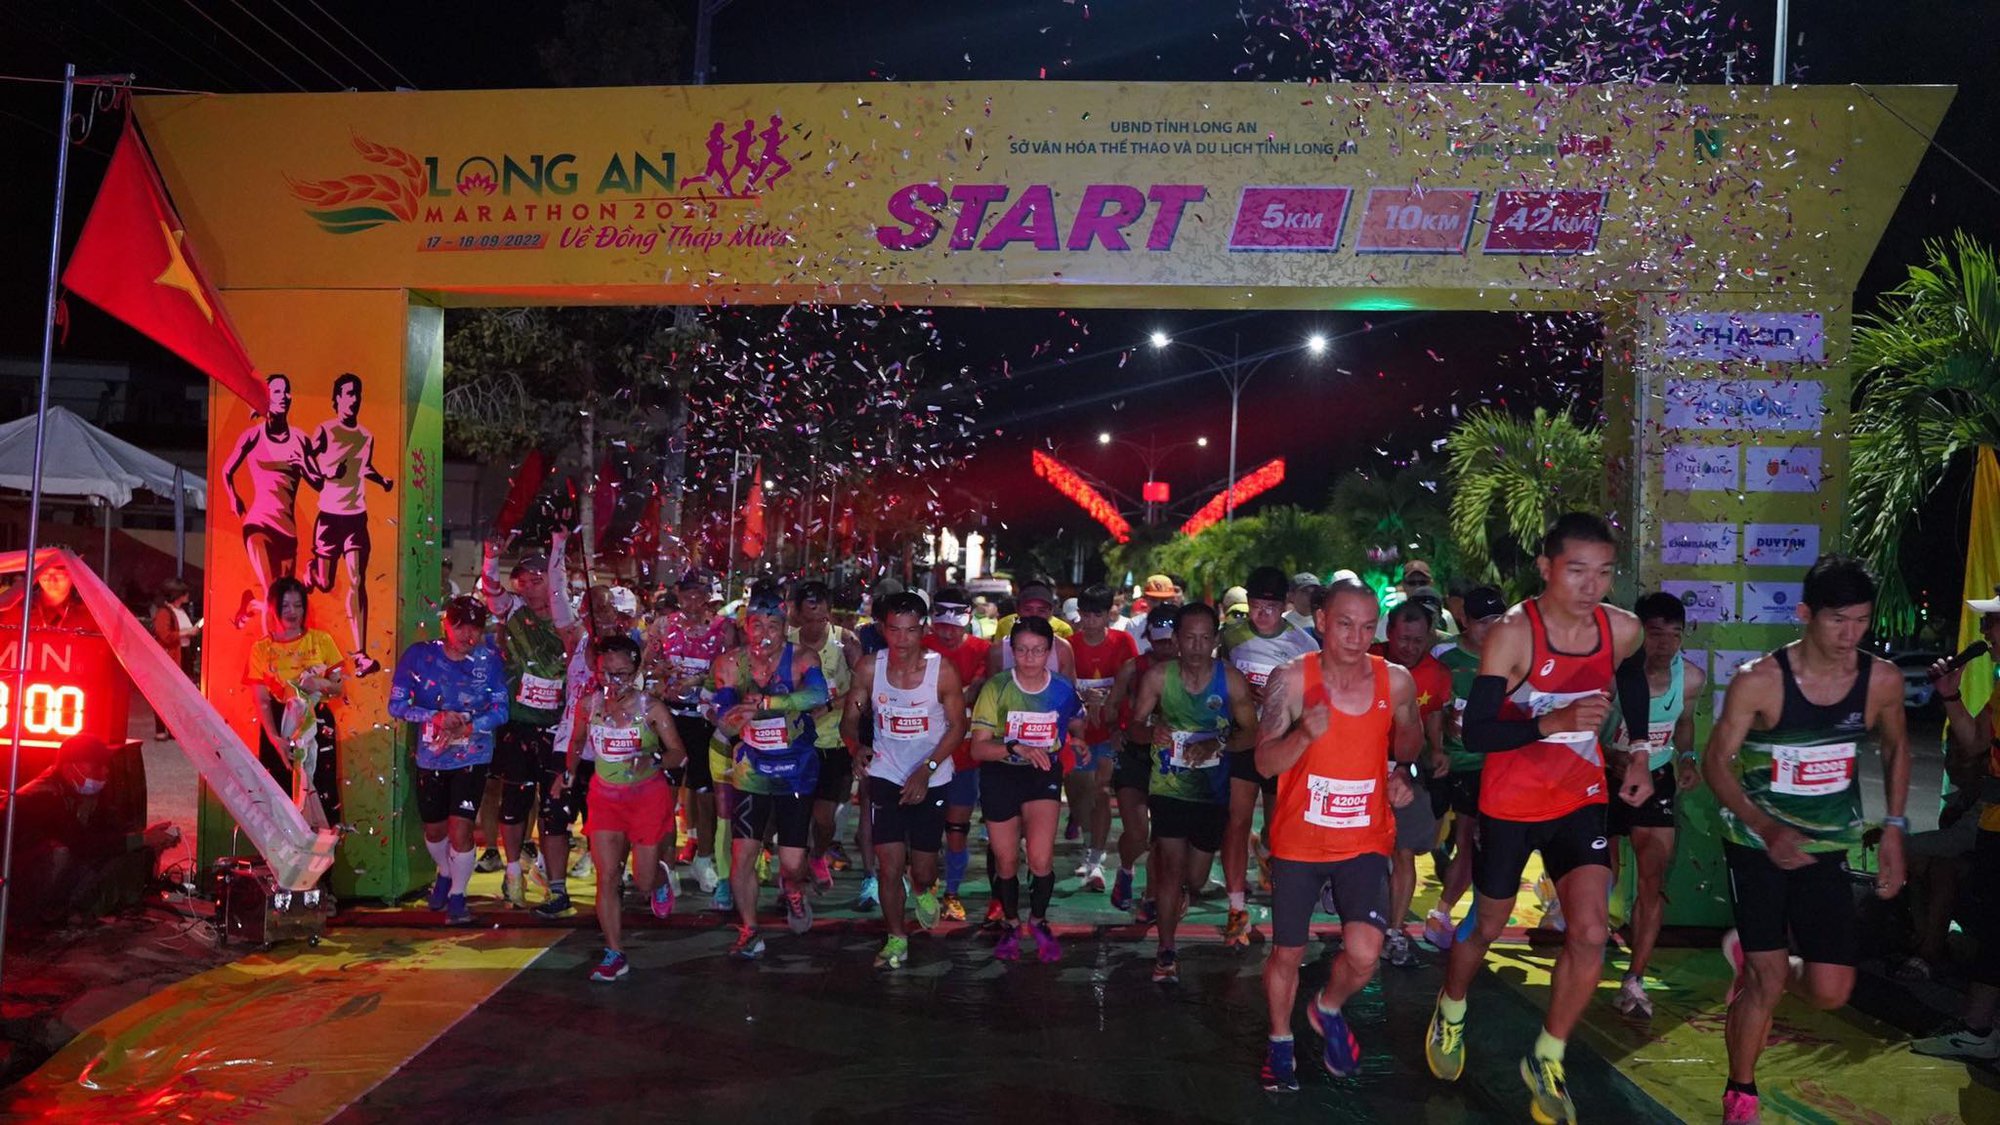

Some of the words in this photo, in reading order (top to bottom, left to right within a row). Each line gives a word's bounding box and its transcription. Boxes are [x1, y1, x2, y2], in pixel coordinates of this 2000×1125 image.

[1111, 121, 1153, 134] UBND
[1156, 117, 1189, 134] TỈNH
[1193, 121, 1233, 134] LONG
[1236, 121, 1257, 134] AN
[1130, 141, 1171, 154] THAO
[1173, 138, 1193, 154] VÀ
[1196, 142, 1217, 154] DU
[1294, 142, 1334, 155] LONG
[425, 153, 578, 197] LONG
[596, 151, 675, 194] AN
[424, 203, 617, 223] MARATHON
[633, 201, 718, 219] 2022
[876, 185, 1206, 251] START
[1261, 204, 1323, 229] 5KM
[1384, 205, 1459, 231] 10KM
[1500, 207, 1593, 231] 42KM
[427, 237, 440, 247] 17
[1331, 796, 1367, 806] 42004
